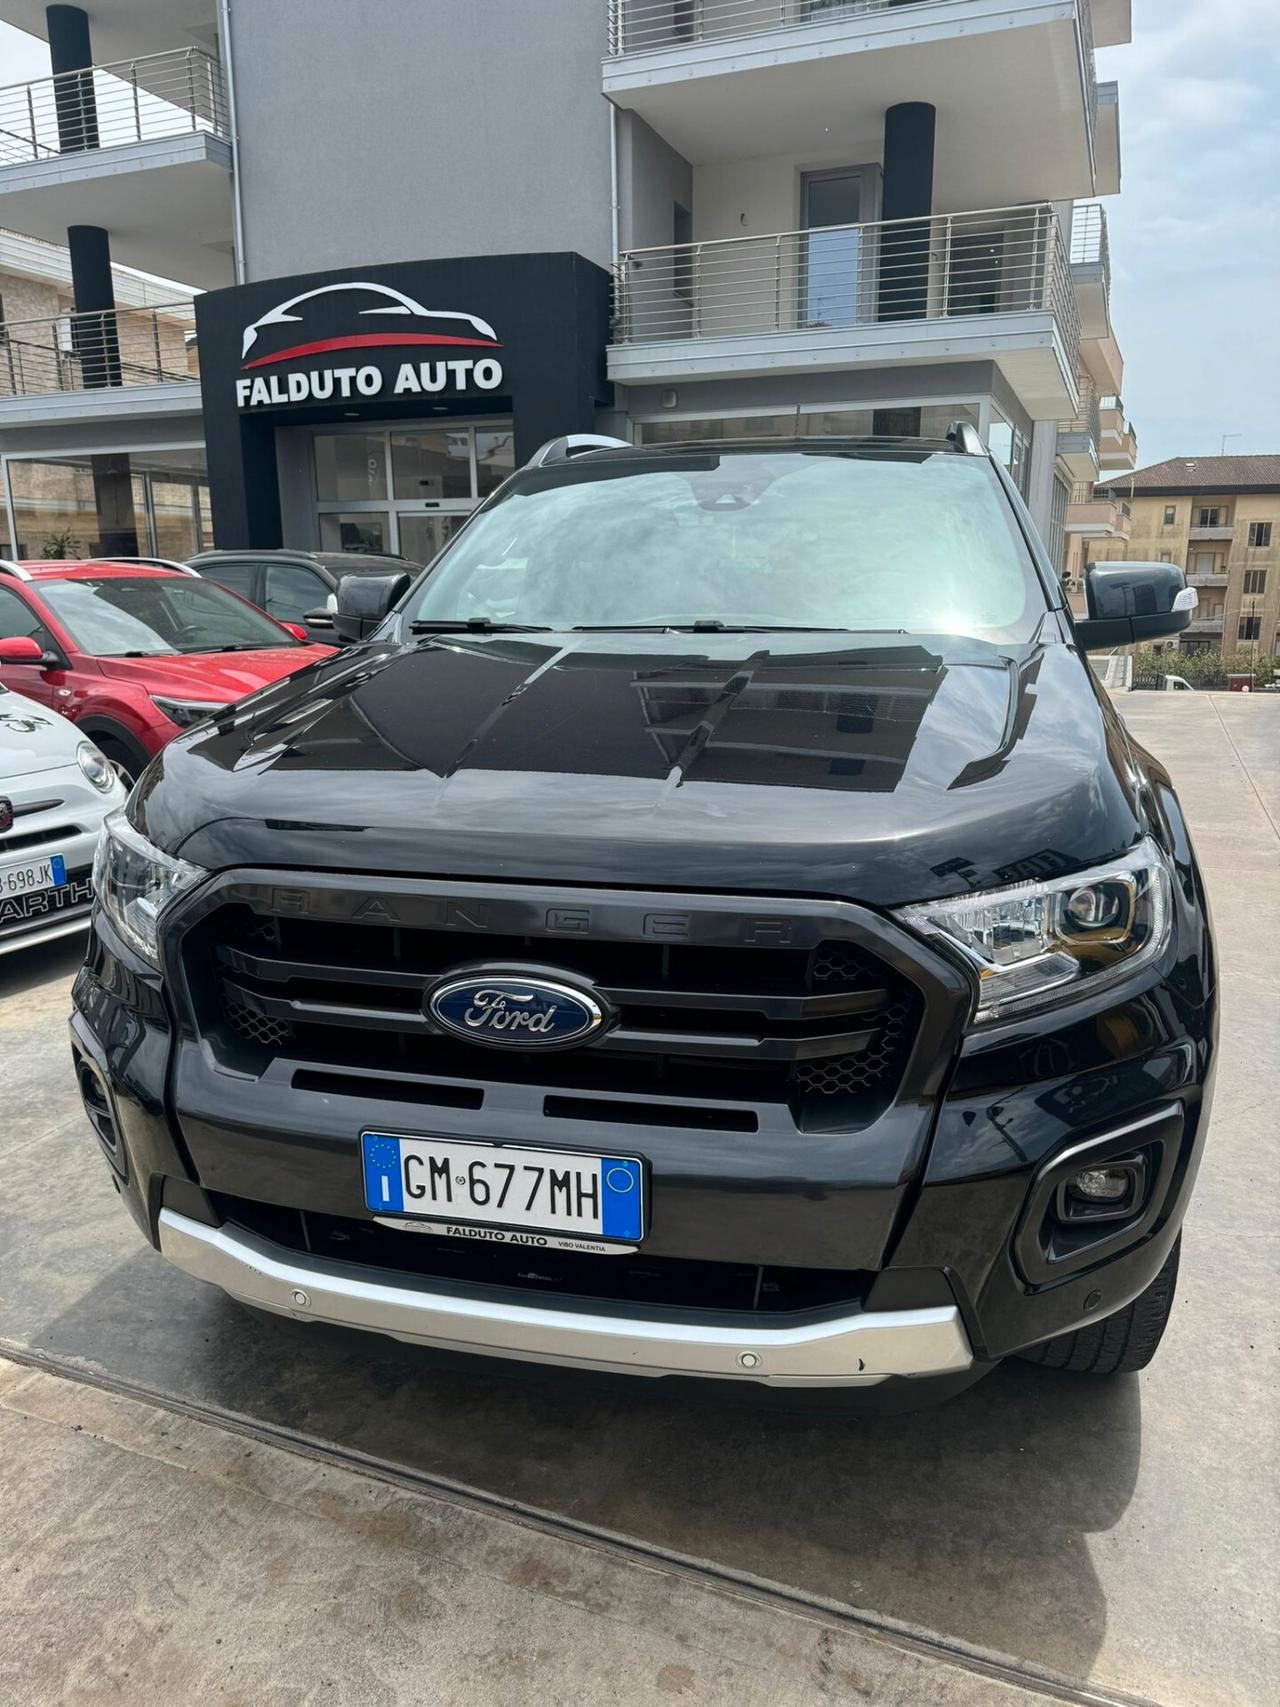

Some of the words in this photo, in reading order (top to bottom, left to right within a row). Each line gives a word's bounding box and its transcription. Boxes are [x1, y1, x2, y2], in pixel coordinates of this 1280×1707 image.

[236, 366, 382, 408] FALDUTO
[393, 358, 502, 394] AUTO
[272, 888, 793, 943] RANGER
[464, 989, 558, 1033] Ford
[446, 1226, 506, 1242] FALDUTO
[510, 1233, 548, 1247] AUTO
[558, 1241, 574, 1249] VIBO
[575, 1242, 607, 1253] VALENTIA
